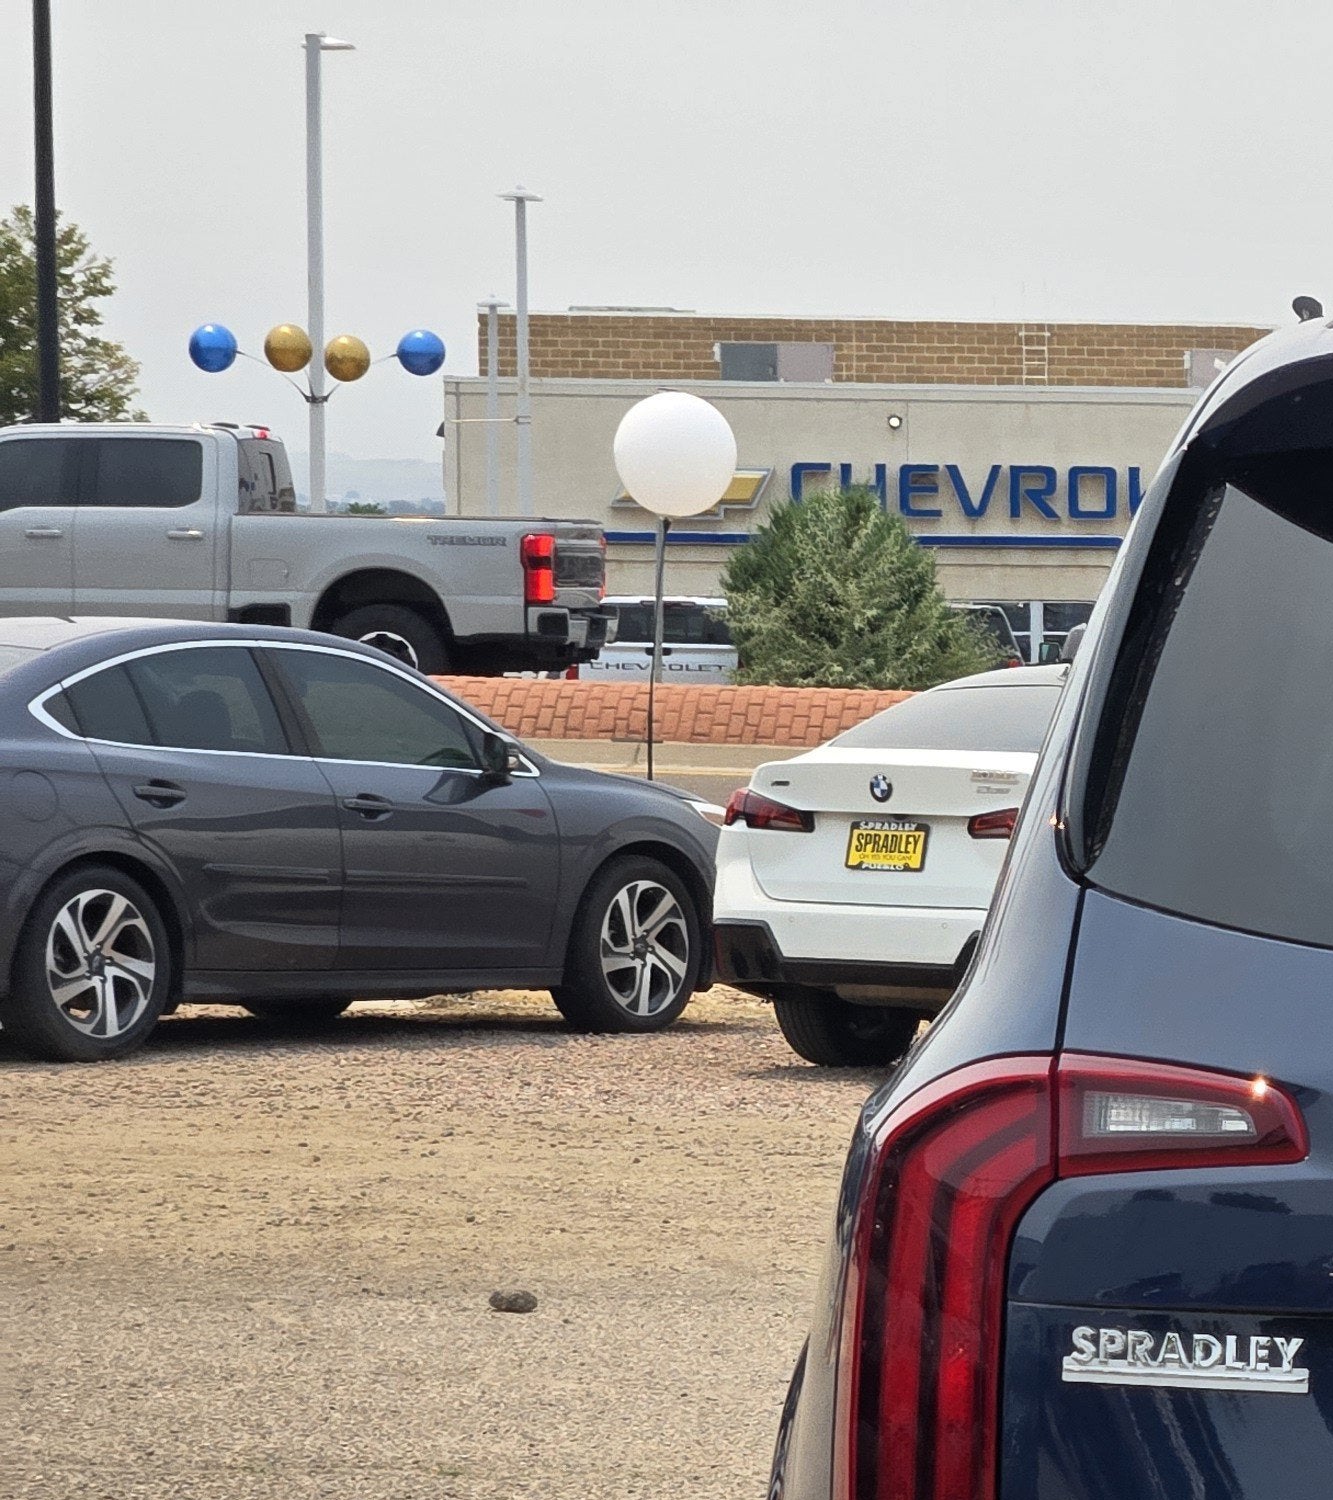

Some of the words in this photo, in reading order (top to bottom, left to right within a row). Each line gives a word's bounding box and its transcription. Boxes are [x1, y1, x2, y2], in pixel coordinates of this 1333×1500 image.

[427, 535, 507, 547] TREMOR
[589, 662, 725, 672] CHEVOLET
[859, 821, 917, 831] SPRADLEY
[855, 833, 921, 854] SPRADLEY
[1071, 1326, 1305, 1373] SPRADLEY
